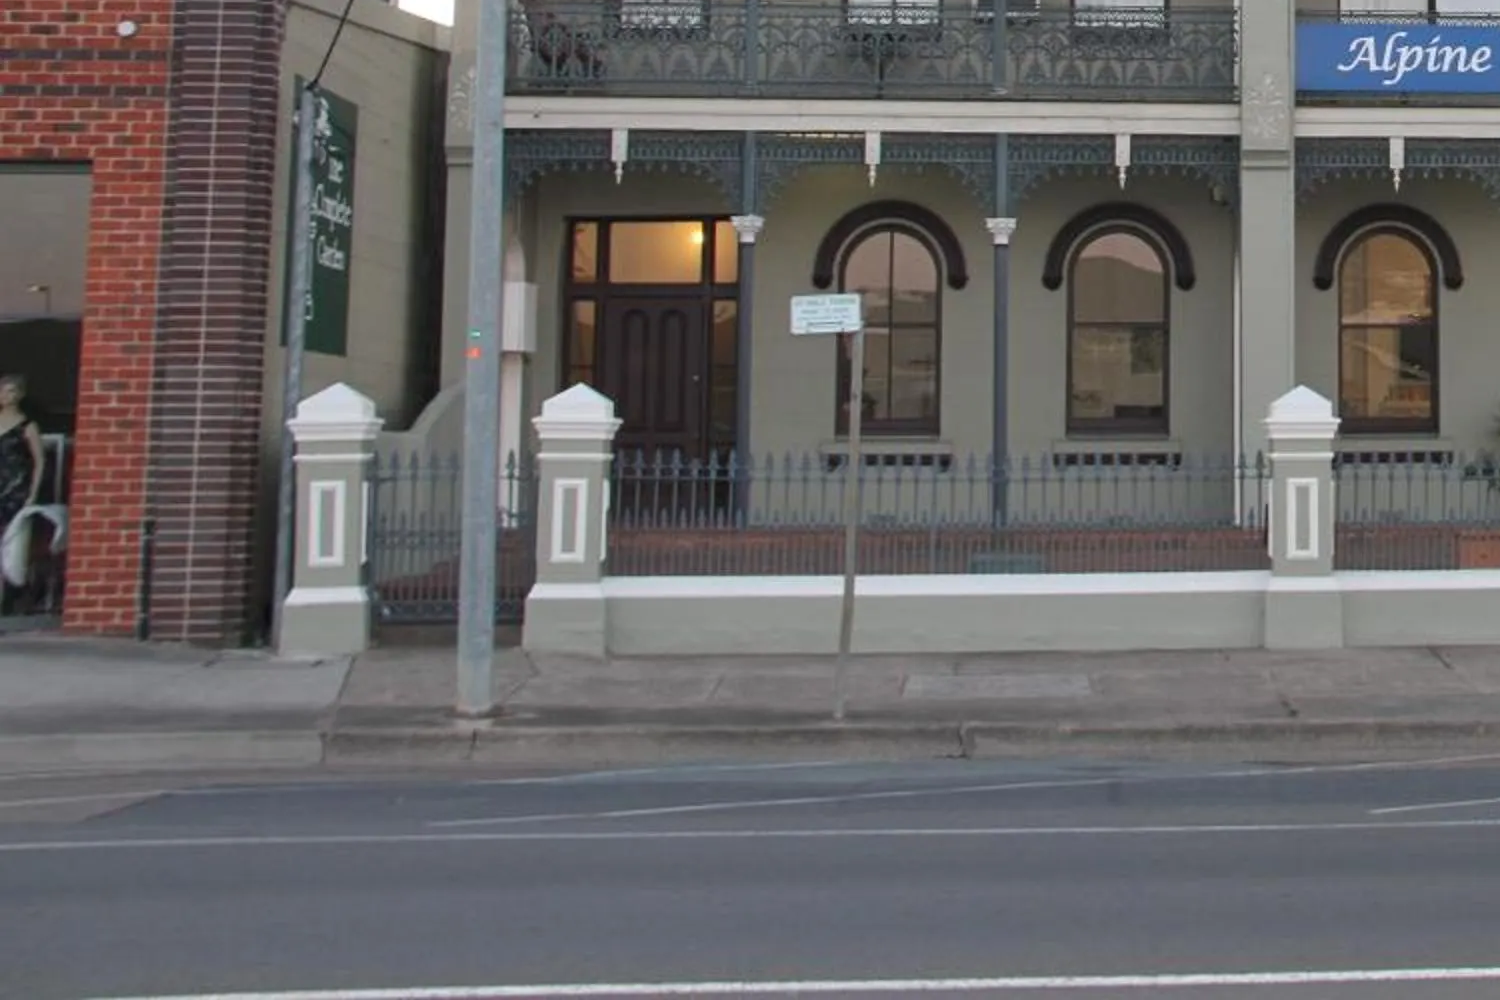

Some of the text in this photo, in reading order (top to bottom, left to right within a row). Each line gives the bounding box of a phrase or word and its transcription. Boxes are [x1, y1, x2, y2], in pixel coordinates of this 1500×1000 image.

[1337, 31, 1493, 86] Alpine
[312, 183, 352, 233] Complete
[317, 235, 345, 271] Garden
